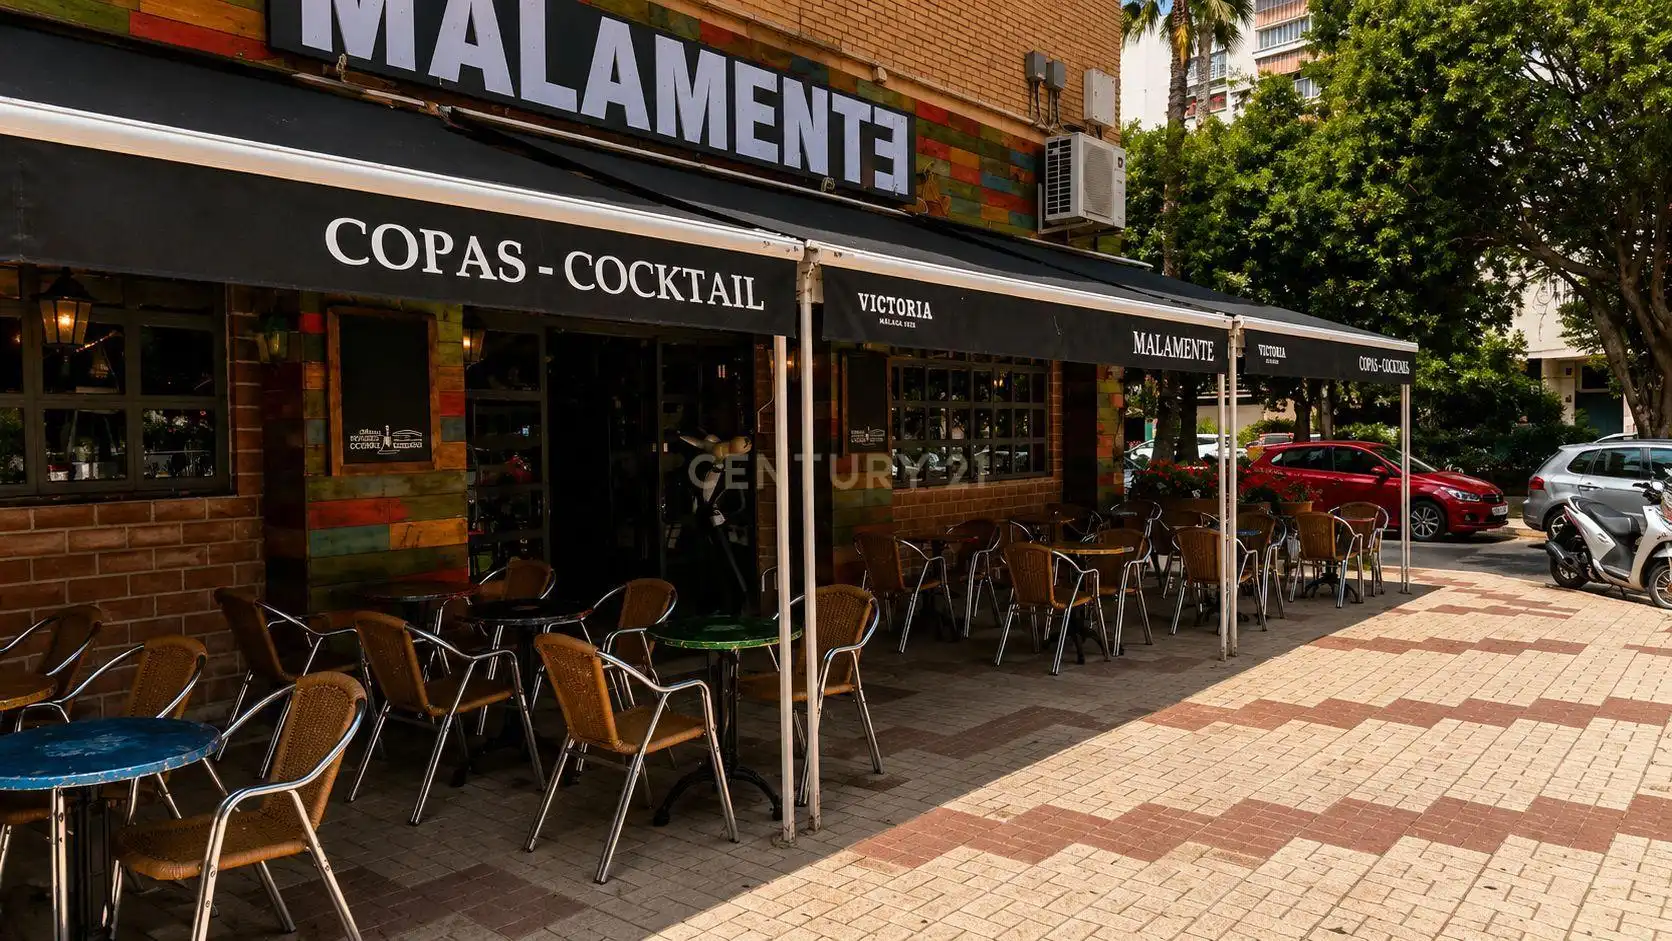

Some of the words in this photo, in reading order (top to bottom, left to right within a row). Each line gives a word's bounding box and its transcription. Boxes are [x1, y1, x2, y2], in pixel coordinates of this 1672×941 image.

[325, 217, 526, 283] COPAS
[564, 251, 764, 311] COCKTAIL
[858, 292, 933, 319] VICTORIA
[1132, 330, 1215, 362] MALAMENTE
[1257, 343, 1287, 359] VICTORIA
